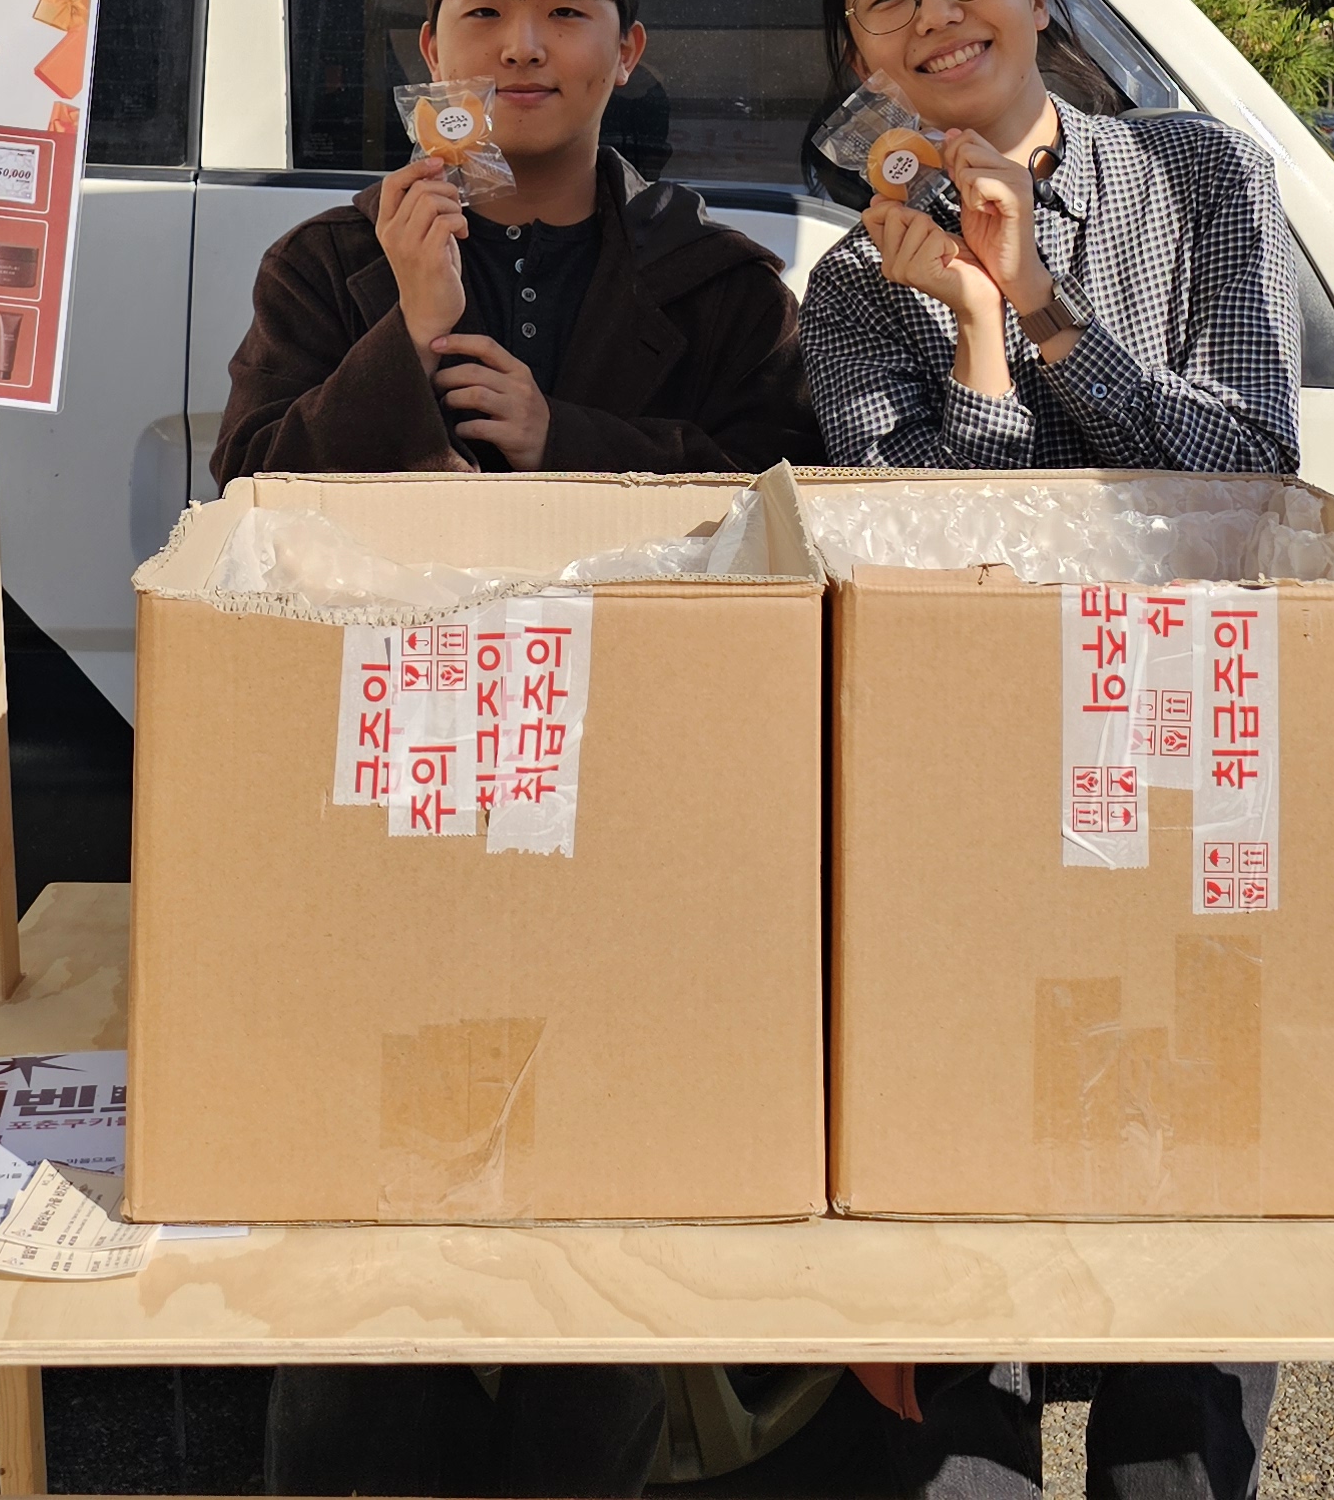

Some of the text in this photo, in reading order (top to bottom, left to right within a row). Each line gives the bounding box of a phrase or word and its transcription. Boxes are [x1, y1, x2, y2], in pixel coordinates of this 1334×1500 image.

[511, 626, 573, 804] 취급주의
[1211, 610, 1259, 790] 취급주의
[409, 745, 457, 834] 주의
